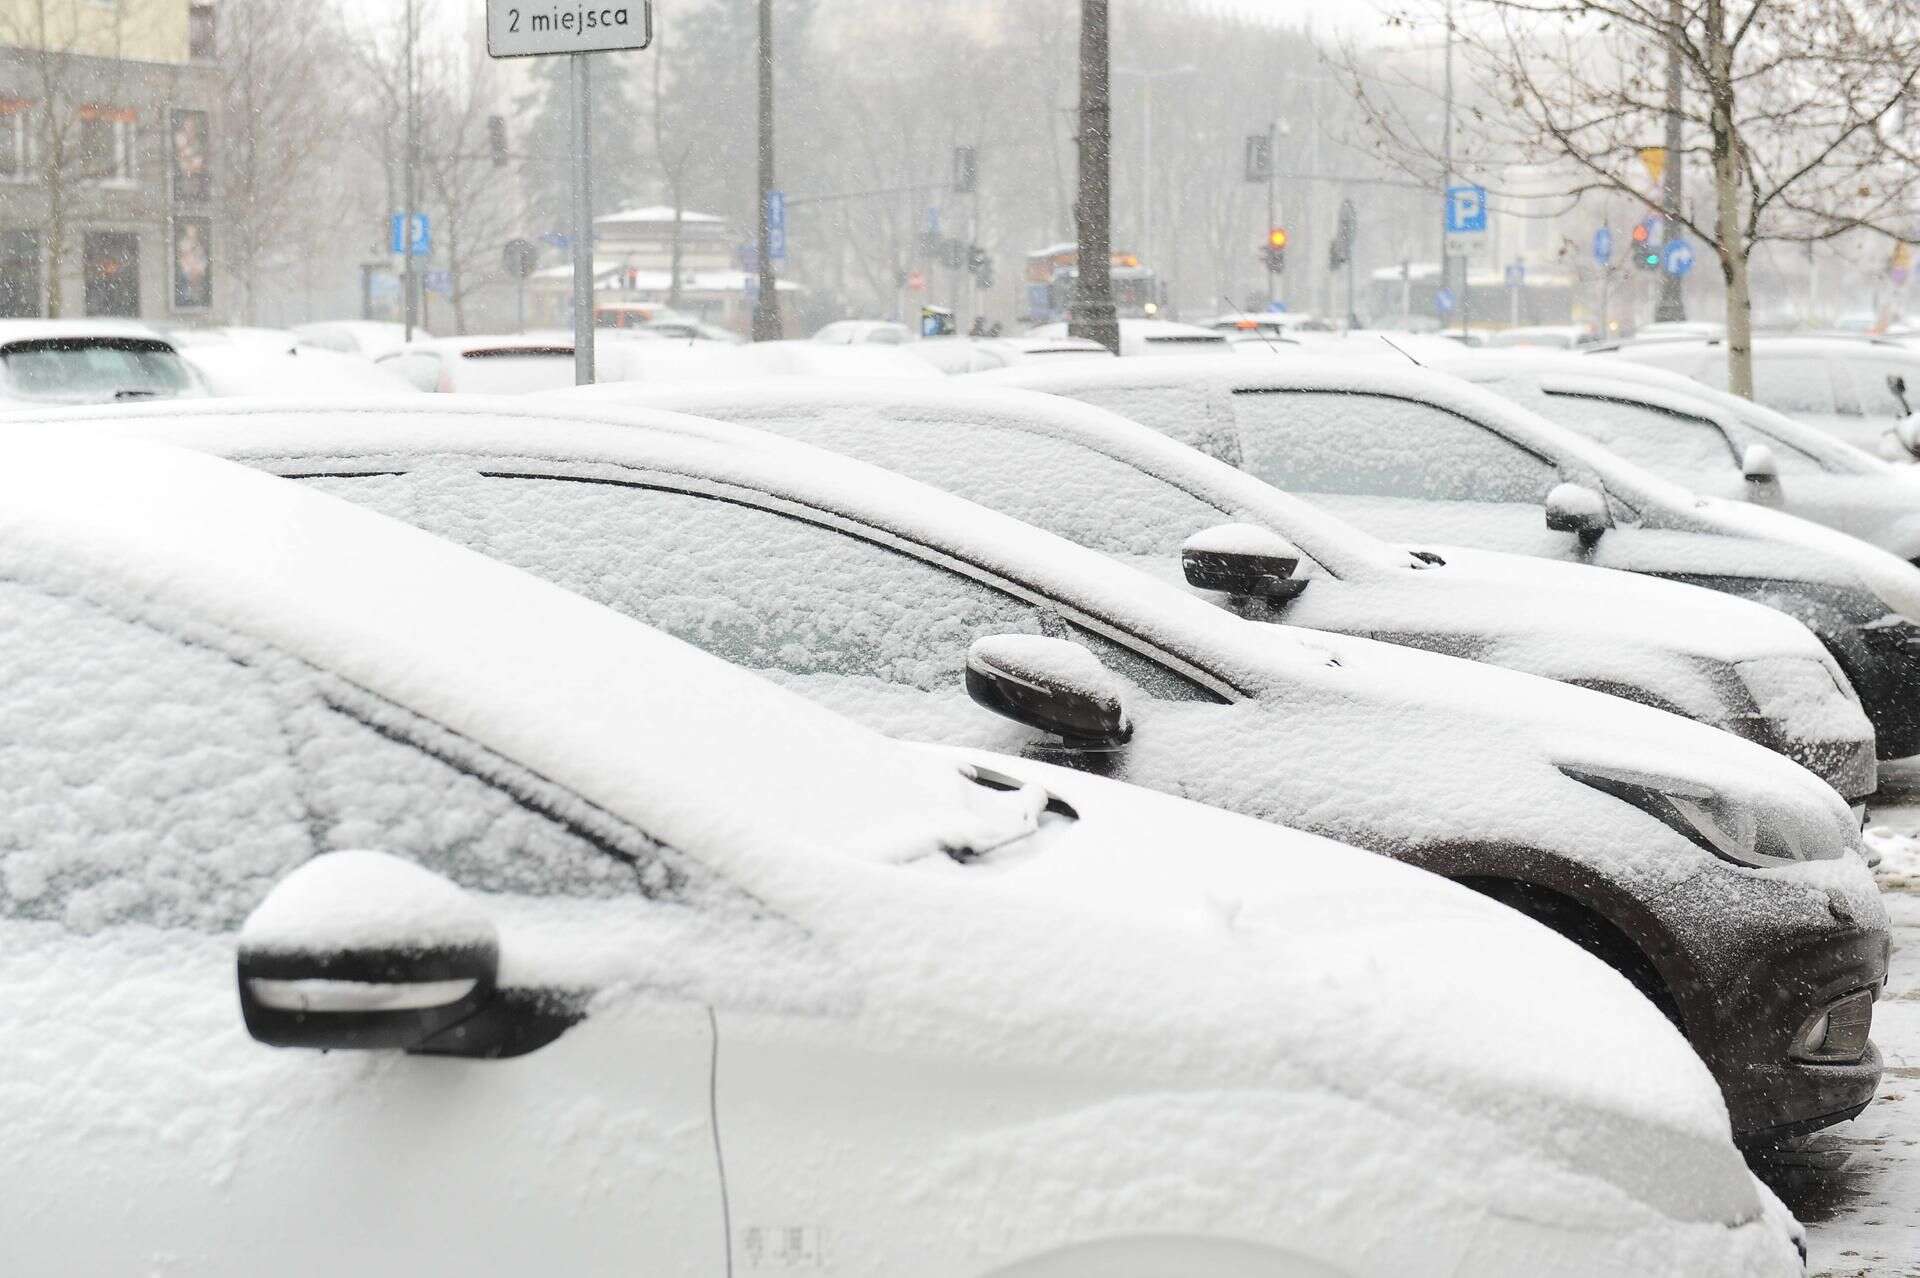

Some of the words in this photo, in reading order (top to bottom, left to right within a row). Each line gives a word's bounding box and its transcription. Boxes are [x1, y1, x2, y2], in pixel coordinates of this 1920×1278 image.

[508, 8, 520, 33] 2
[531, 3, 629, 35] miejsca
[1455, 191, 1480, 229] P
